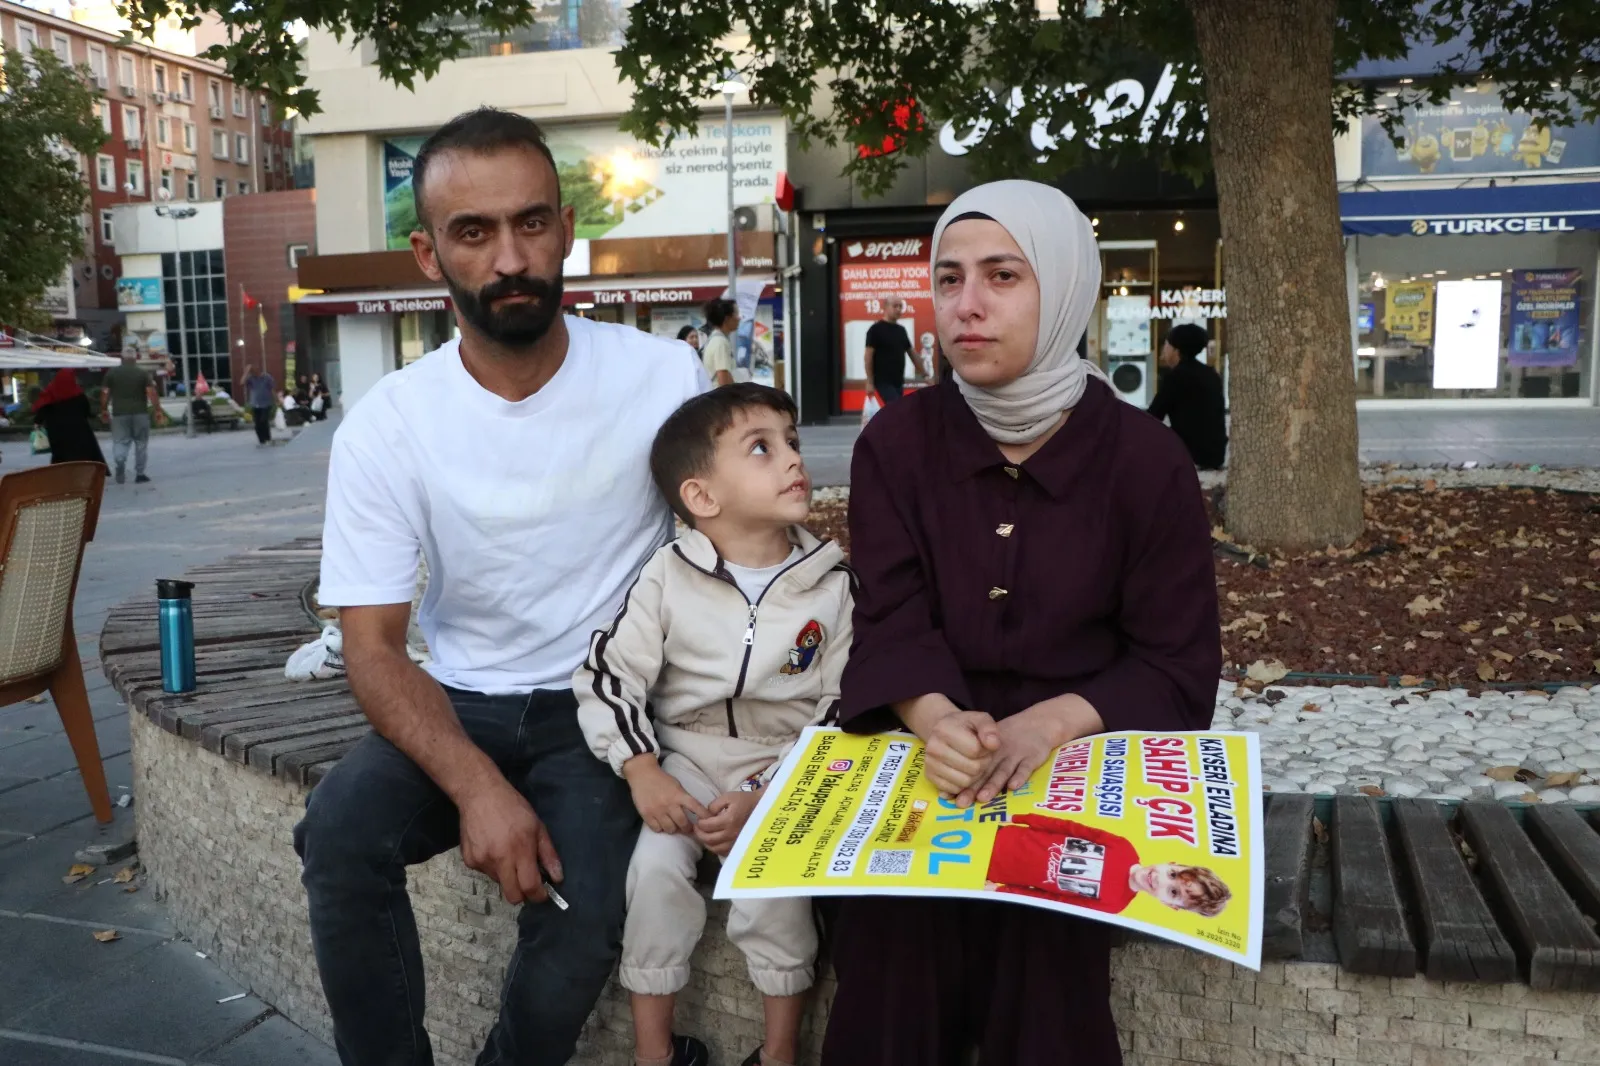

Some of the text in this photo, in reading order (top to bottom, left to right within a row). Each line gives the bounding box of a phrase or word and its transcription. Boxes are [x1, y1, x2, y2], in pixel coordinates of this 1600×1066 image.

[680, 146, 718, 159] çekim
[665, 162, 683, 174] siz
[732, 175, 773, 188] orada.
[1429, 218, 1575, 234] TURKCELL
[865, 239, 923, 260] arçelik
[842, 269, 868, 280] DAHA
[869, 268, 901, 279] UCUZU
[357, 298, 446, 313] Türk Telekom
[593, 288, 693, 304] Türk Telekom
[811, 735, 836, 765] BABASI
[797, 764, 820, 786] EMRE
[1036, 742, 1092, 812] EYMEN ALTAŞ
[1094, 738, 1127, 818] DMD SAVAŞÇISI
[780, 787, 807, 812] ALTAŞ
[1136, 737, 1198, 844] SAHİP ÇIK
[1199, 738, 1237, 855] KAYSERİ EVLADINA
[786, 773, 845, 845] Yakupeymenaltas
[768, 817, 790, 834] 0537
[758, 837, 777, 853] 508
[928, 829, 973, 875] OL
[747, 855, 769, 879] 0101
[834, 860, 851, 872] 83
